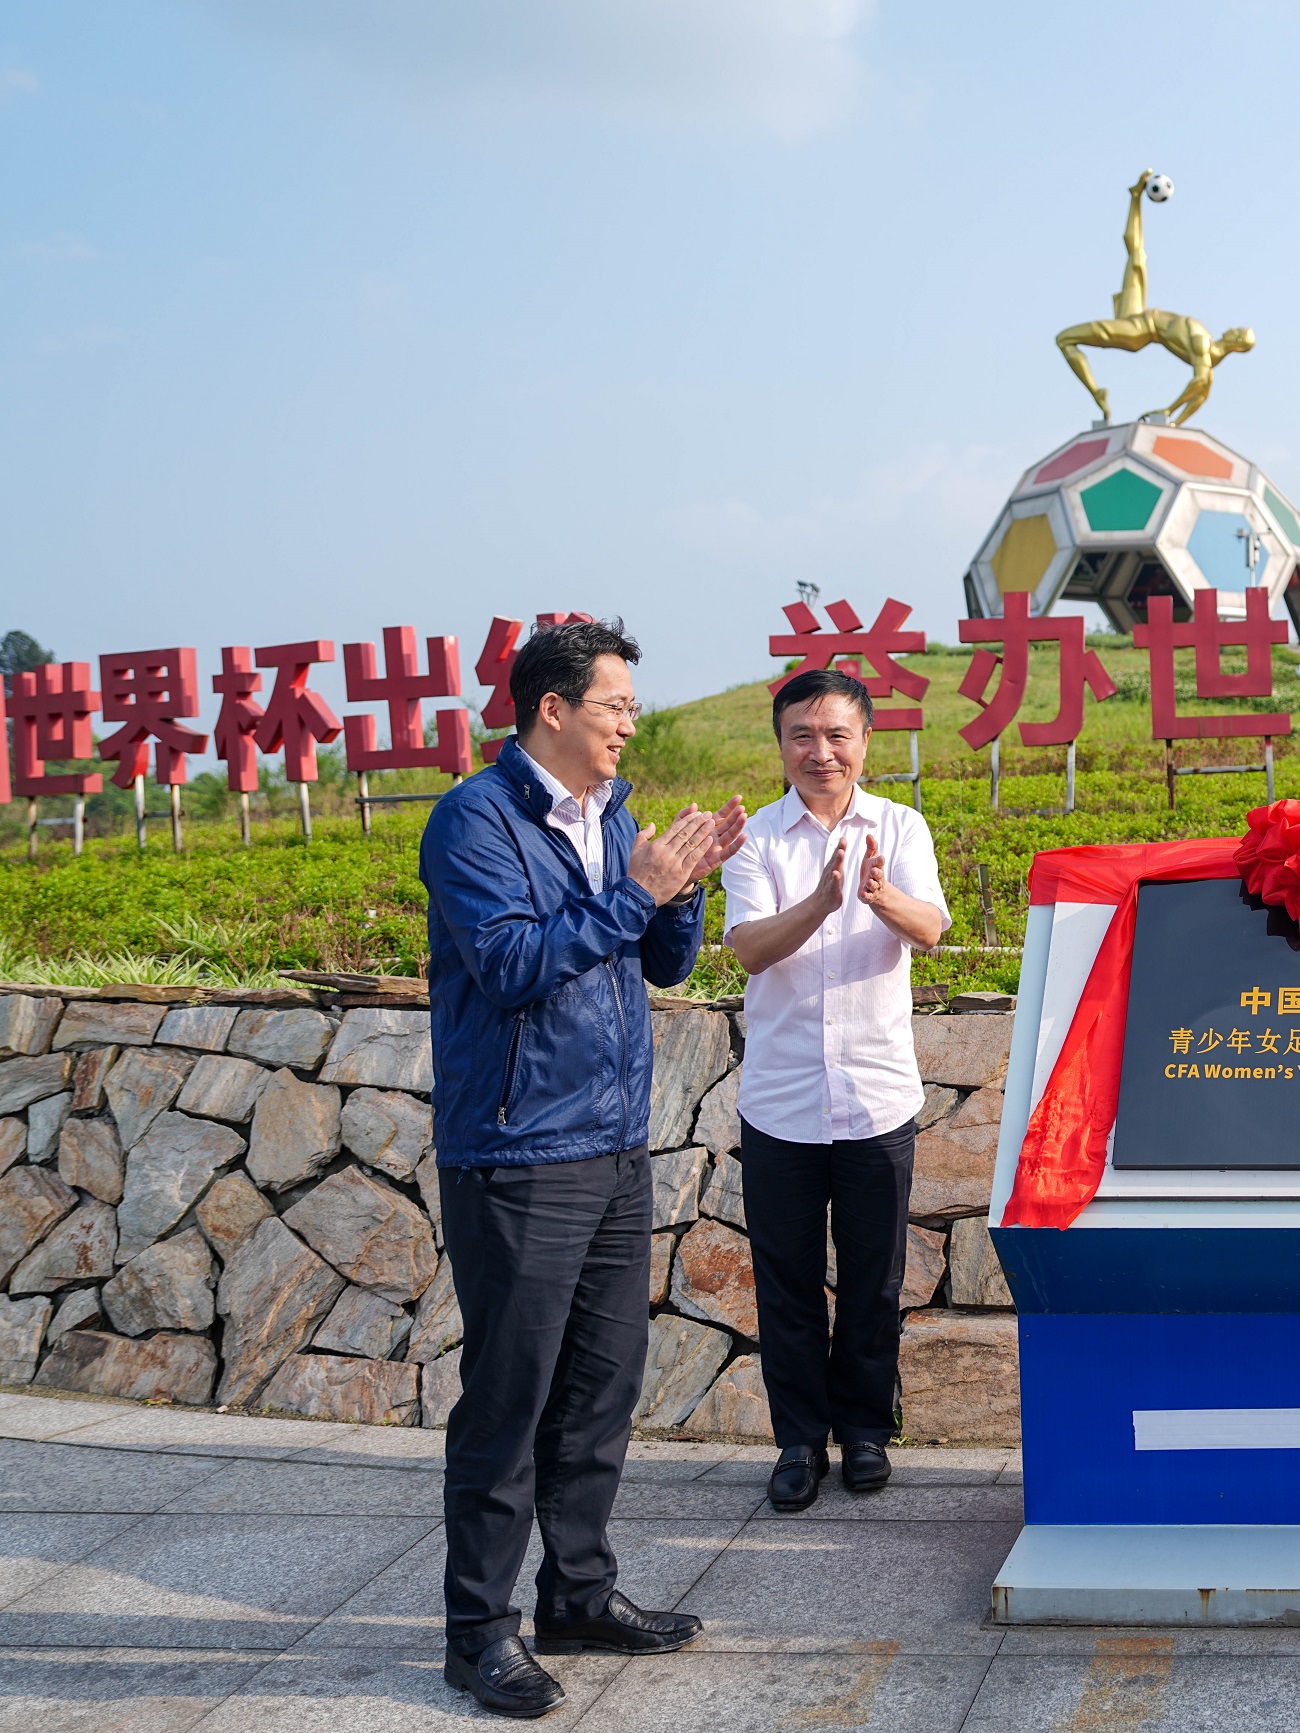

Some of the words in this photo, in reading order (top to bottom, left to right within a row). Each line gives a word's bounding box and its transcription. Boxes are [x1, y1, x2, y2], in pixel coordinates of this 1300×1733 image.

[0, 612, 598, 804] 世界杯出
[1164, 1063, 1200, 1079] CFA
